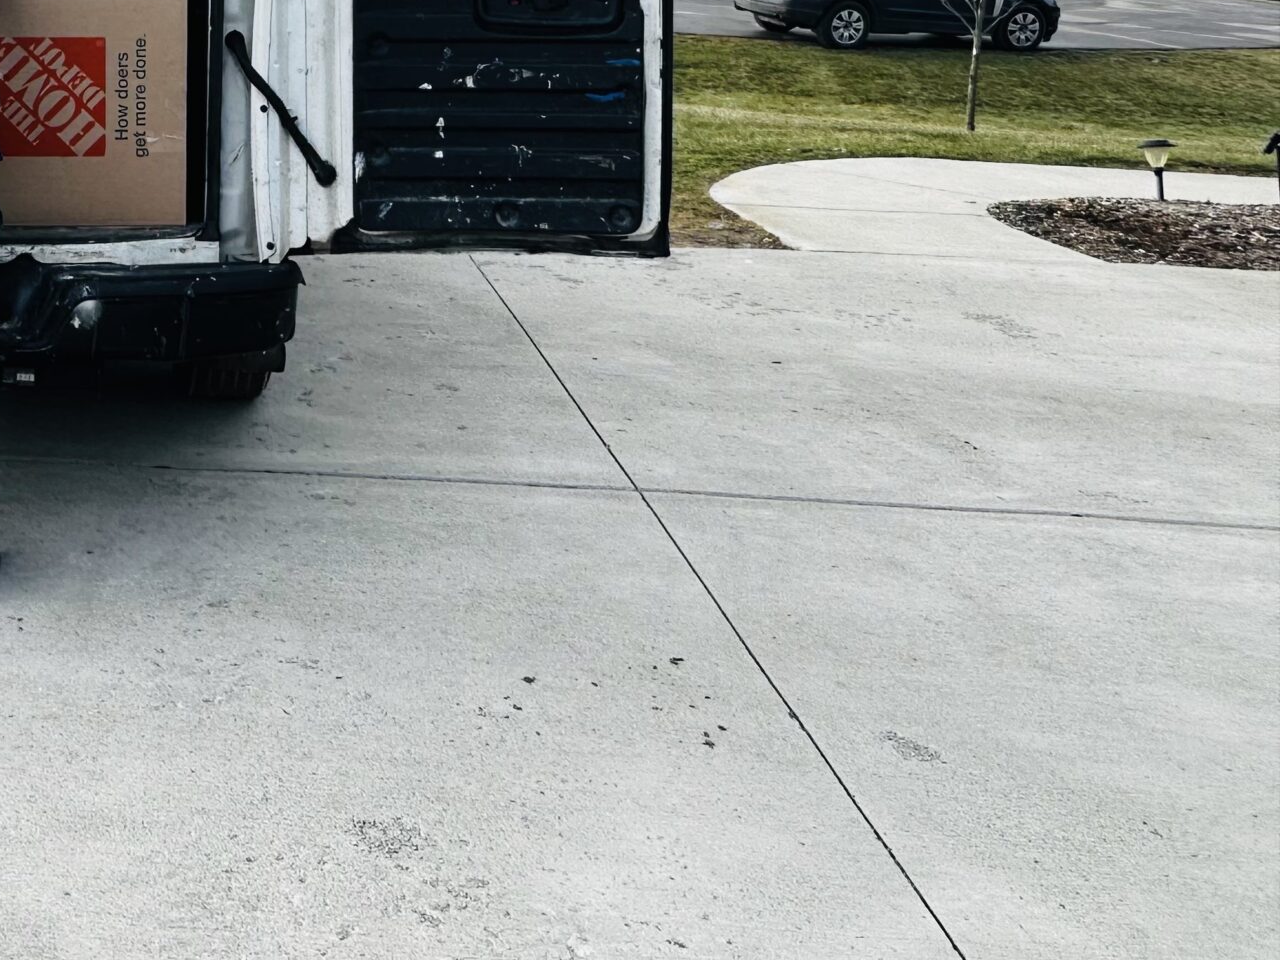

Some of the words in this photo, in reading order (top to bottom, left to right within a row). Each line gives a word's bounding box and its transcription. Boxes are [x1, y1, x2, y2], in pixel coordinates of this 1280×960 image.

[29, 37, 105, 111] DEPOT
[115, 52, 128, 96] doers
[133, 34, 146, 79] done.
[0, 96, 46, 145] THE
[115, 101, 128, 141] How
[135, 84, 146, 127] more
[135, 132, 149, 158] get
